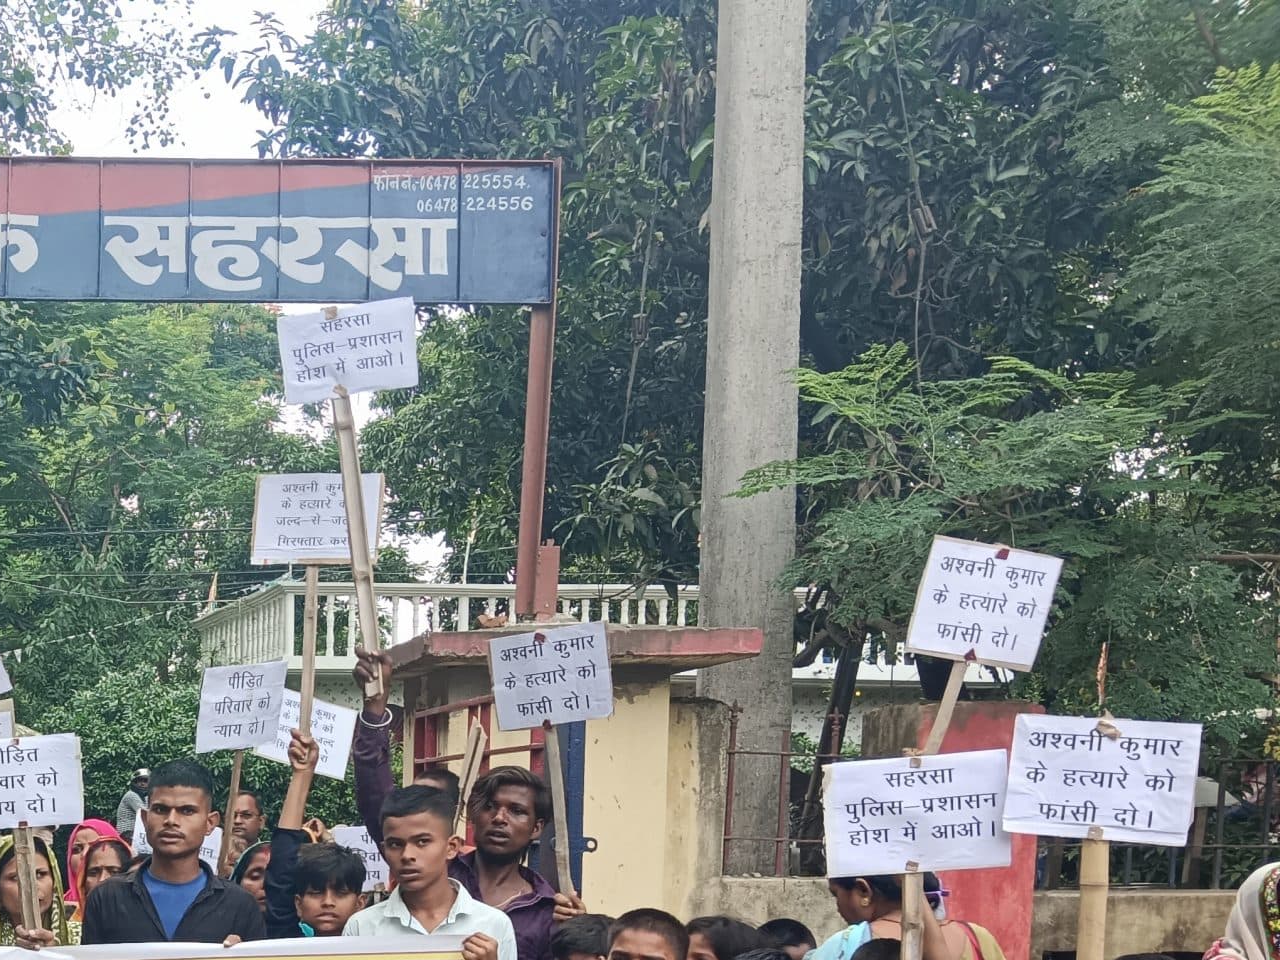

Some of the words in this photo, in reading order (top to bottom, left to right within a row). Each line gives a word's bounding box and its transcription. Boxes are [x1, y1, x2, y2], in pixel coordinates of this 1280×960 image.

[104, 215, 458, 292] सहरसा
[320, 313, 370, 333] सहरसा
[297, 364, 326, 382] होश
[336, 358, 347, 374] में
[282, 480, 319, 493] अश्वनी
[281, 497, 291, 509] के
[300, 498, 331, 509] हत्यारे
[278, 535, 323, 546] गिरफ्तार
[941, 556, 997, 578] अश्वनी
[1005, 566, 1047, 589] कुमार
[933, 584, 949, 604] के
[960, 592, 1008, 614] हत्यारे
[1017, 598, 1037, 618] को
[938, 621, 983, 643] फांसी
[501, 638, 543, 662] अश्वनी
[552, 635, 594, 658] कुमार
[504, 672, 516, 689] के
[525, 664, 567, 688] हत्यारे
[576, 660, 596, 679] को
[214, 697, 252, 714] परिवार
[258, 692, 271, 710] को
[517, 696, 552, 716] फांसी
[214, 724, 241, 737] न्याय
[1029, 728, 1103, 752] अश्वनी
[1119, 735, 1182, 761] कुमार
[36, 767, 58, 786] को
[884, 767, 954, 788] सहरसा
[1026, 761, 1047, 784] के
[1062, 766, 1129, 789] हत्यारे
[1144, 768, 1175, 793] को
[1039, 799, 1098, 824] फांसी
[849, 823, 889, 847] होश
[902, 820, 917, 841] में
